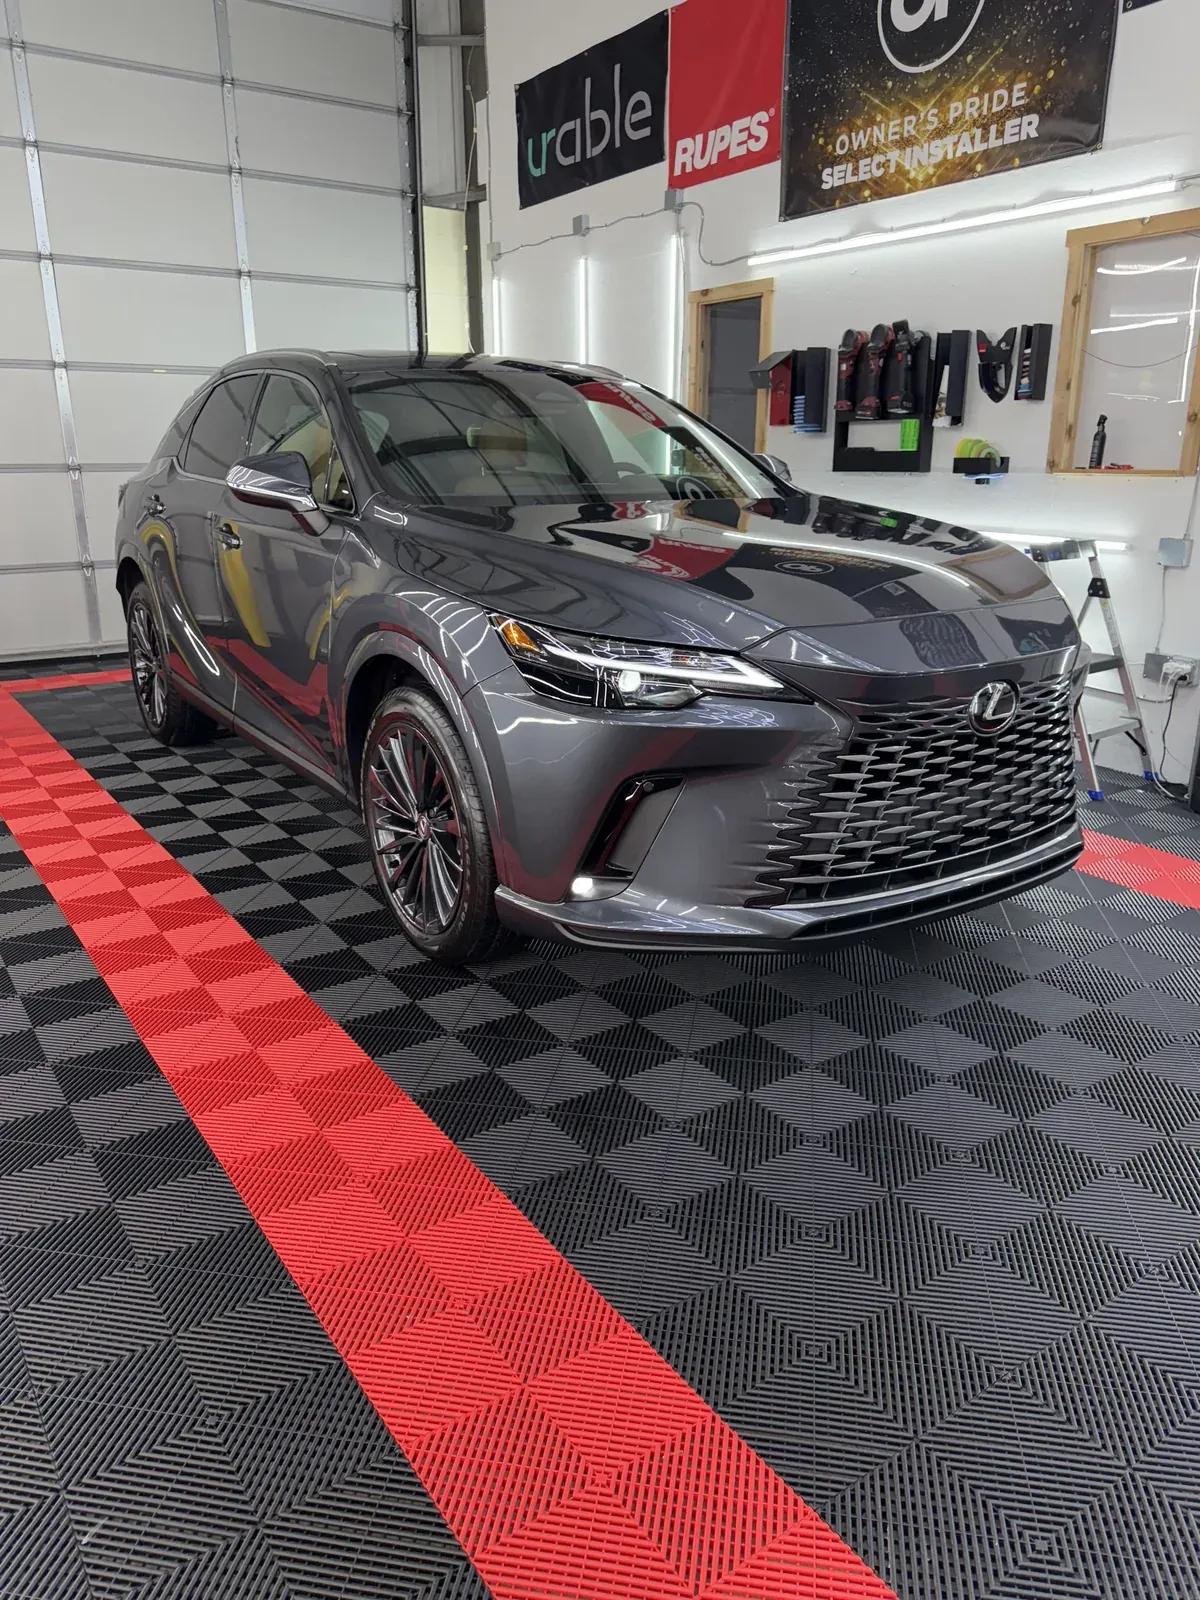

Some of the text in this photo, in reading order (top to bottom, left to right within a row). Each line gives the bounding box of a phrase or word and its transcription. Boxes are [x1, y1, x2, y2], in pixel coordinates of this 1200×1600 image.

[527, 63, 652, 177] urable
[821, 113, 1040, 190] SELECT INSTALLER
[836, 82, 1028, 156] OWNER'S PRIDE
